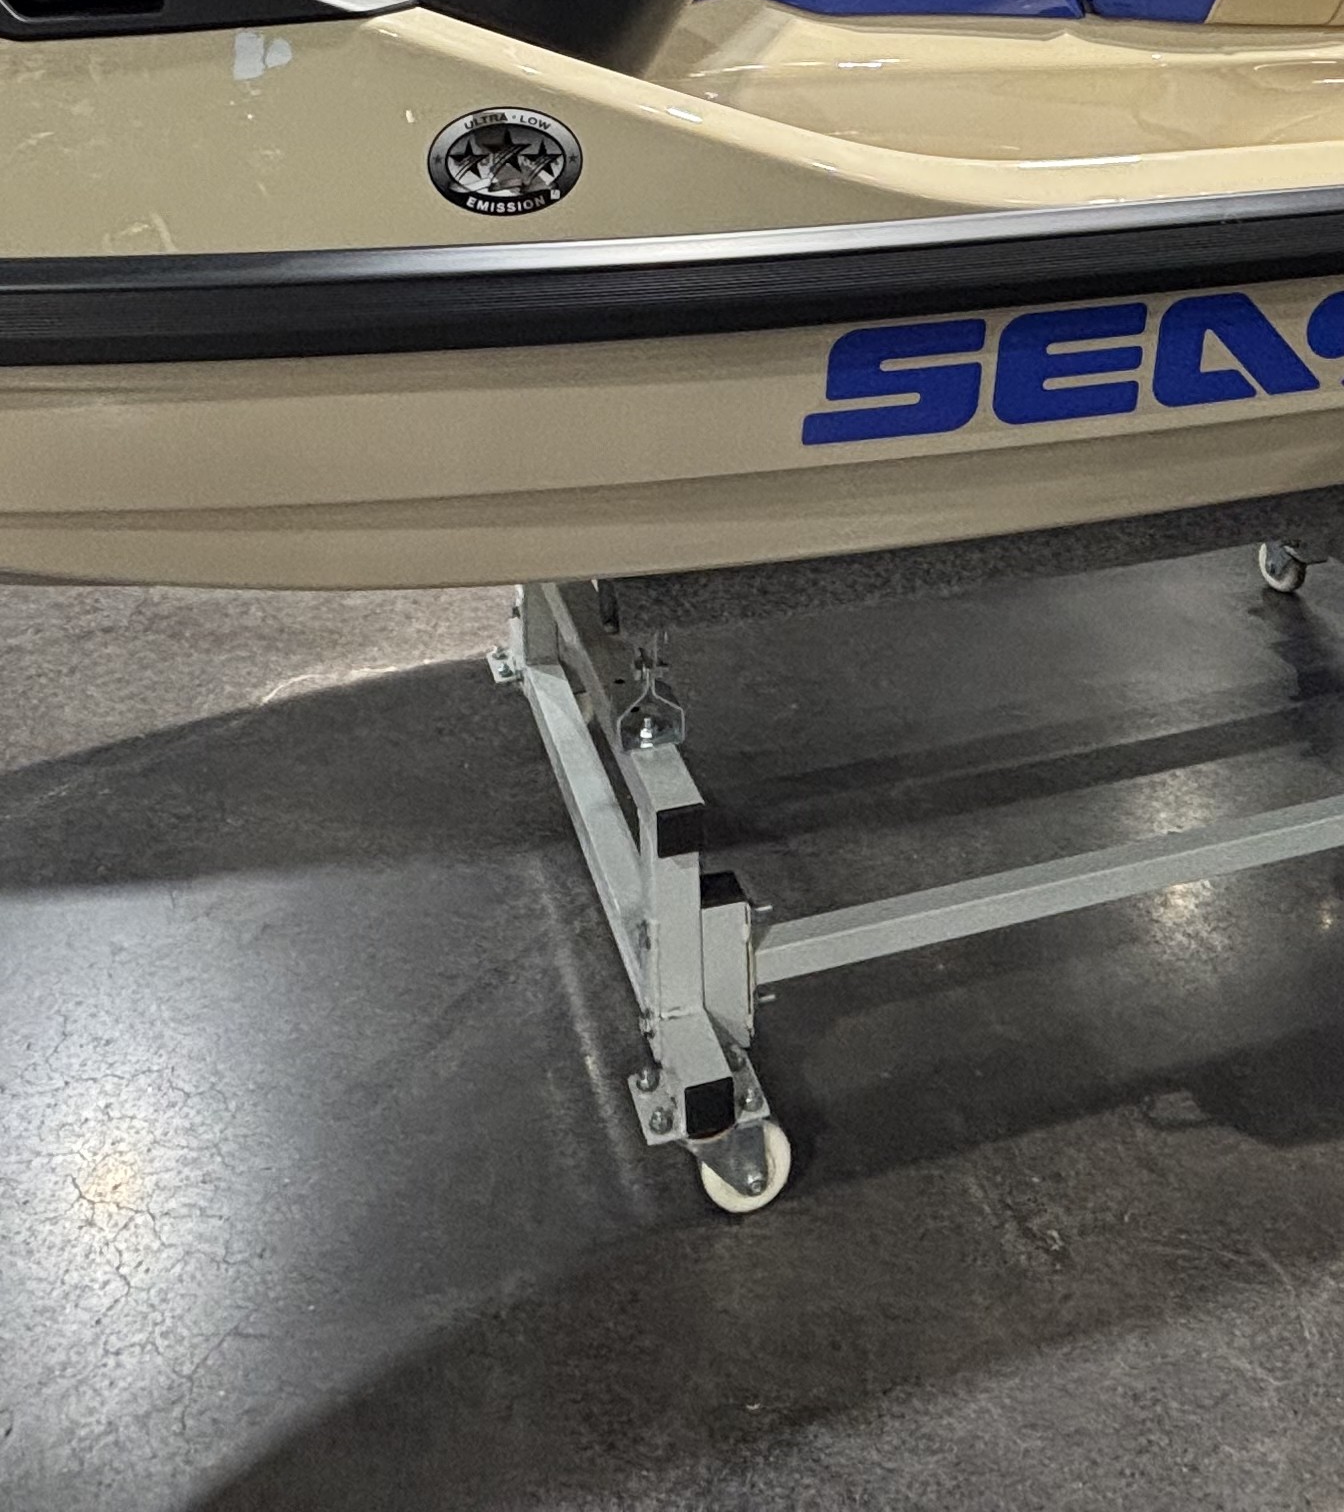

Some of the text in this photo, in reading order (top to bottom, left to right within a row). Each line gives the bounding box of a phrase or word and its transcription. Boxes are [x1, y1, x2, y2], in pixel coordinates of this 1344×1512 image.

[463, 111, 552, 131] ULTRA LOW
[466, 195, 546, 214] EMISSION
